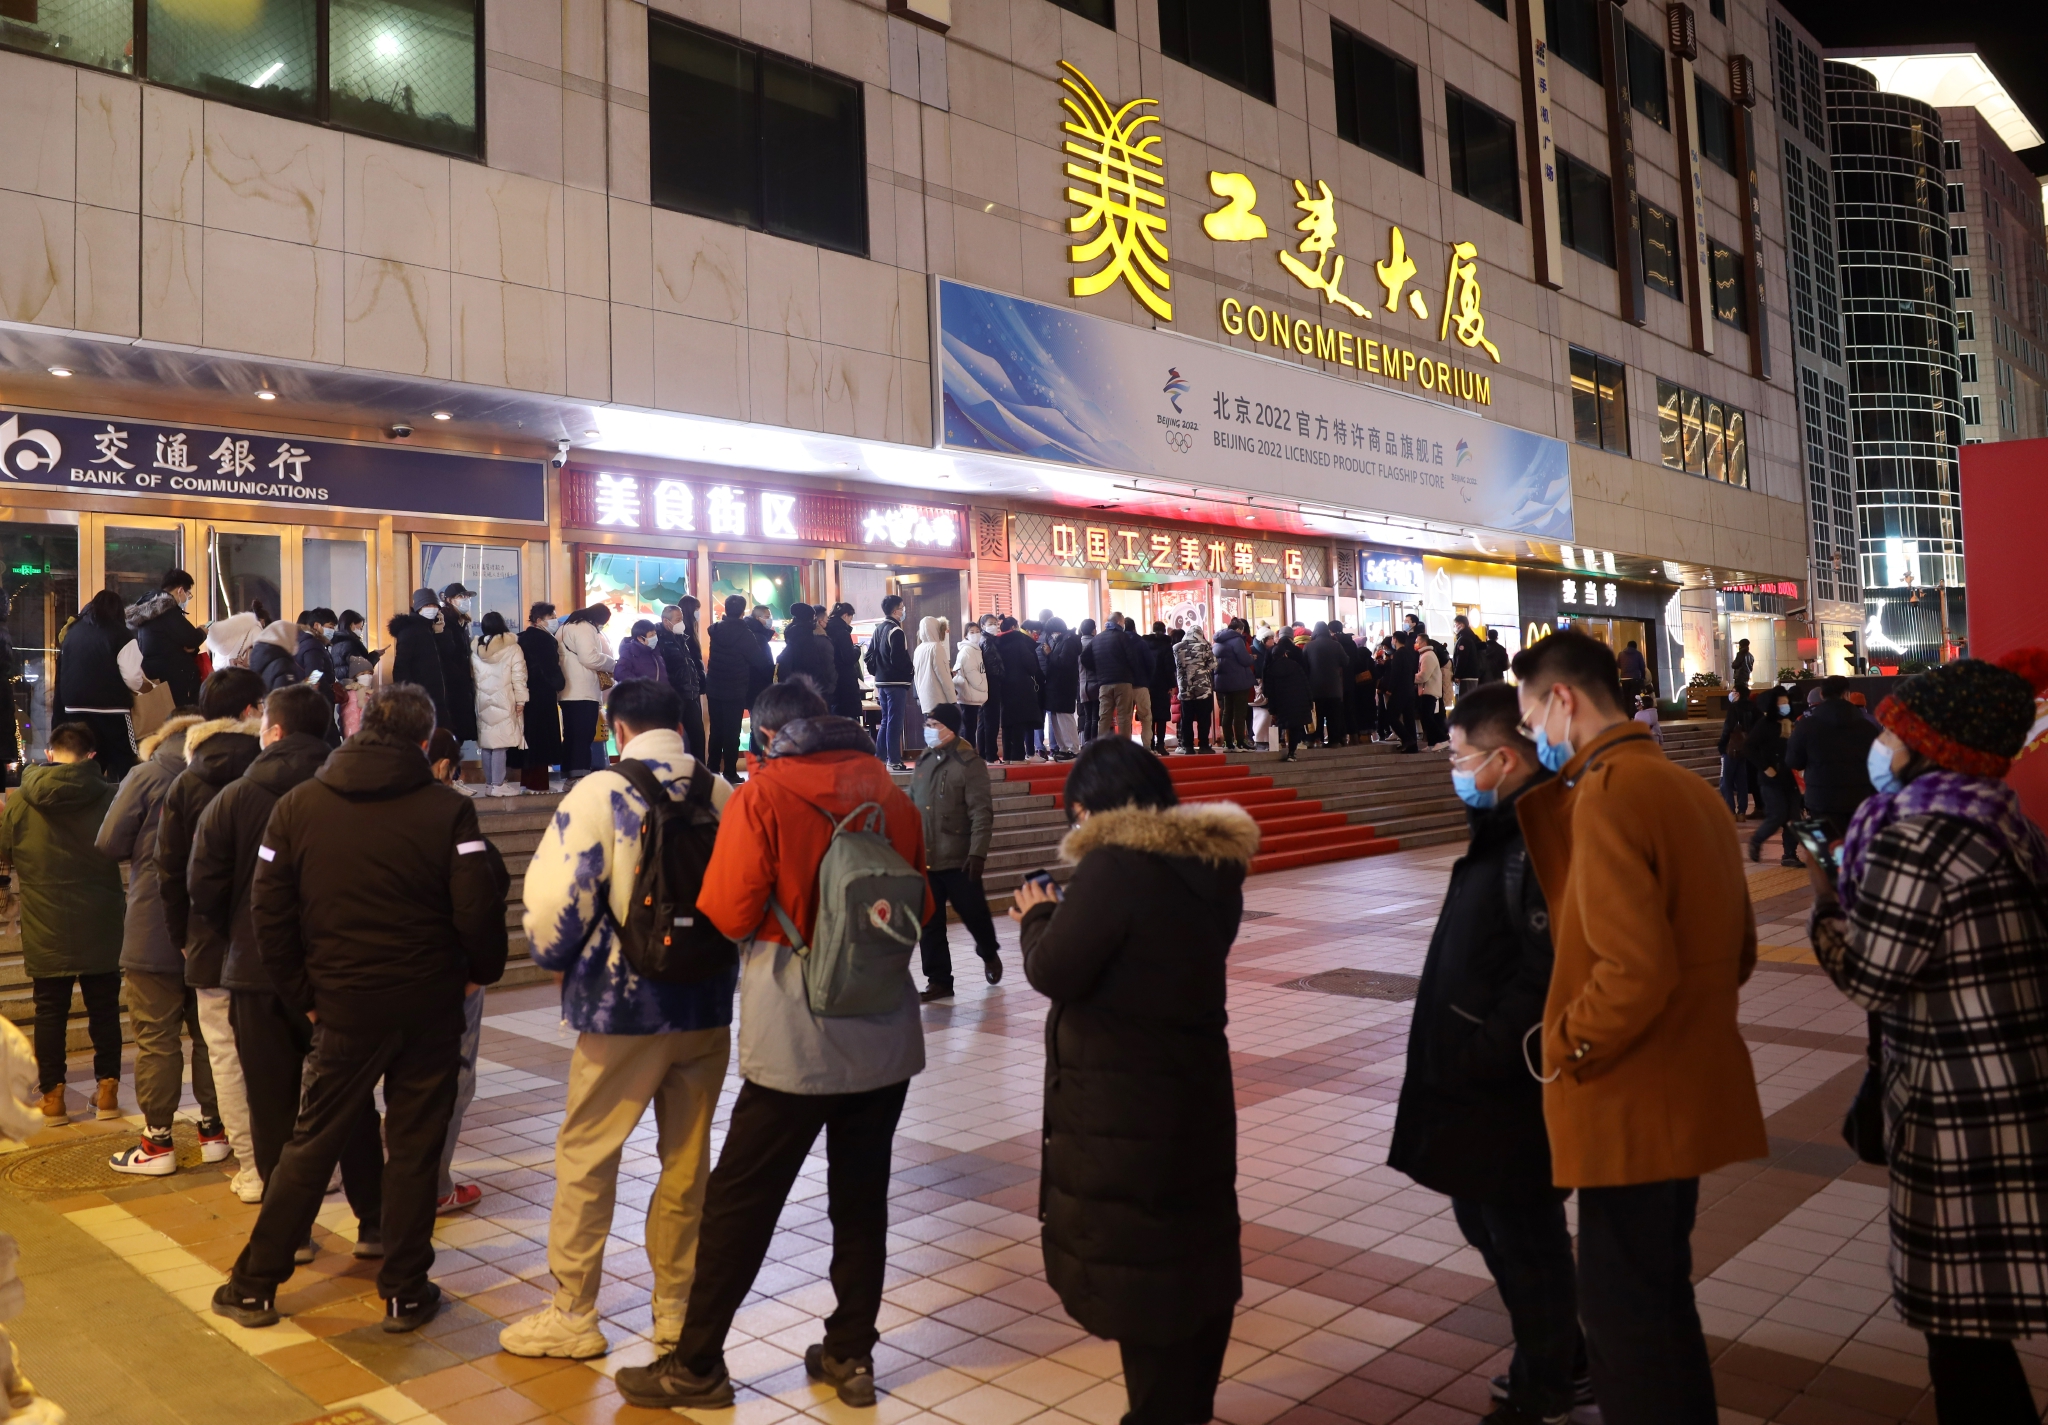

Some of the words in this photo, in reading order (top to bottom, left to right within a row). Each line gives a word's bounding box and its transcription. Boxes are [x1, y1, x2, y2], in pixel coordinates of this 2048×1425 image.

[1537, 78, 1554, 182] 手机广场
[1203, 170, 1501, 363] 工美大厦
[1219, 298, 1491, 406] GONGMEIEMPORIUM
[1157, 415, 1180, 428] BEIJING
[1181, 420, 1199, 430] 2022
[89, 424, 311, 482] 交通銀行
[1213, 431, 1255, 453] BEIJING
[1257, 440, 1282, 458] 2022
[1285, 445, 1330, 467] LICENSED
[1333, 455, 1376, 475] PRODUCT
[1379, 464, 1417, 483] FLAGSHIP
[1420, 472, 1444, 489] STORE
[70, 468, 126, 485] BANK
[136, 473, 162, 488] OF
[170, 476, 329, 500] COMMUNICATIONS
[595, 473, 799, 540] 美食街区
[1051, 523, 1302, 580] 中国工艺美术第一店
[1562, 579, 1617, 607] 麦当劳
